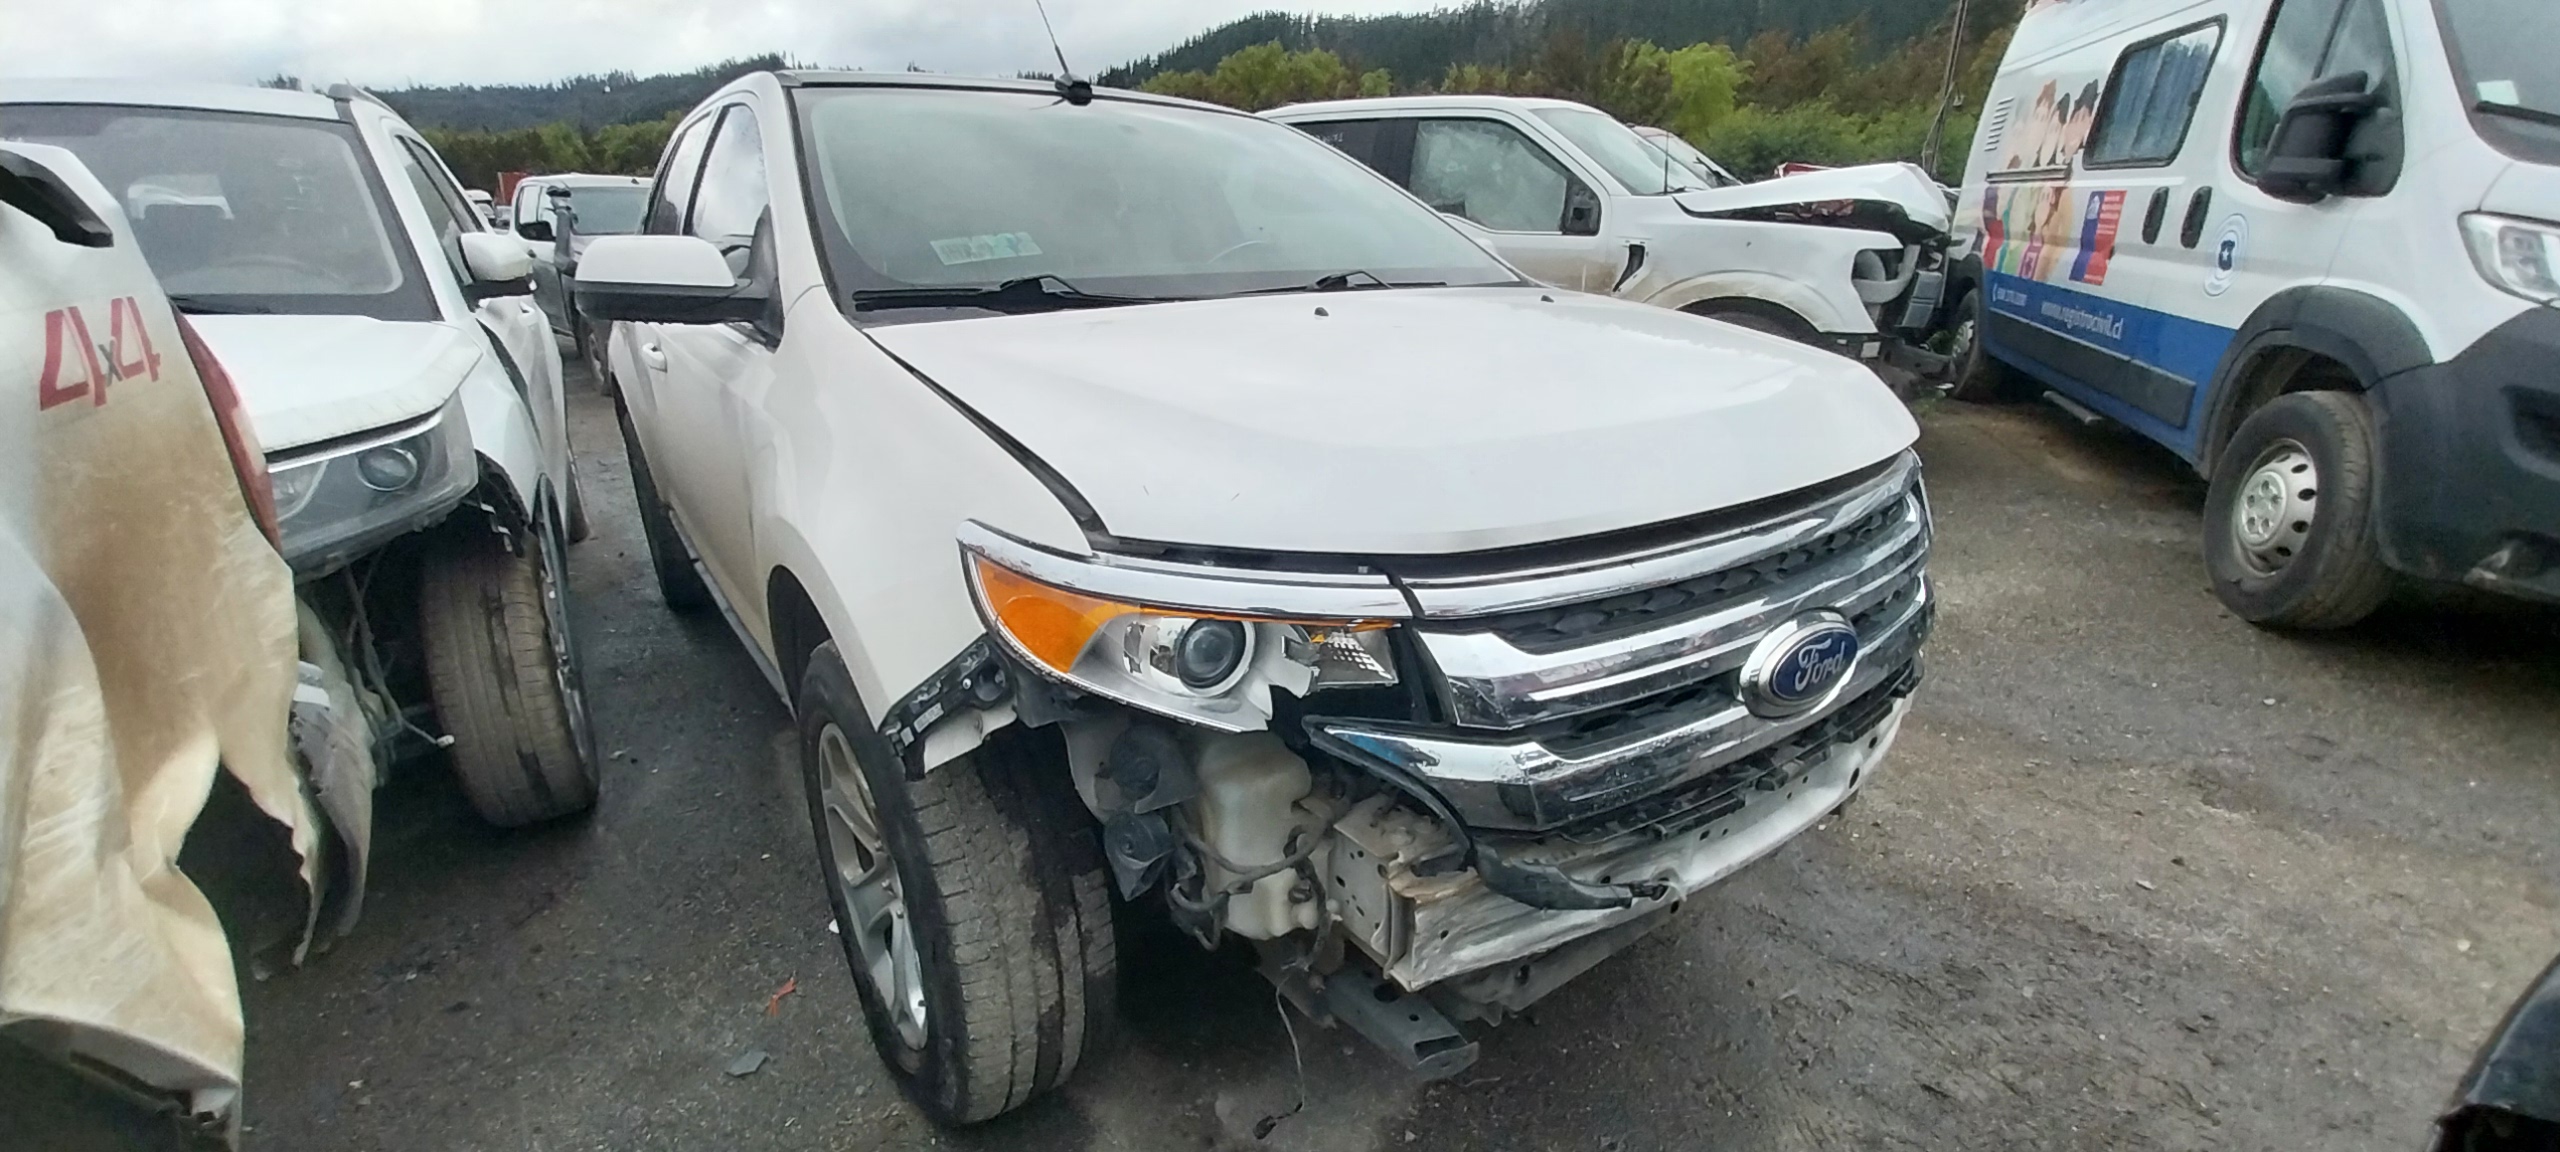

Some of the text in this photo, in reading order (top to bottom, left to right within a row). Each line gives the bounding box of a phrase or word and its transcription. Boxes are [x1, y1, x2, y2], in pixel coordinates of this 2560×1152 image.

[2041, 301, 2123, 340] www.registrocivil.cl
[40, 296, 161, 411] 4x4
[1794, 638, 1846, 691] Ford
